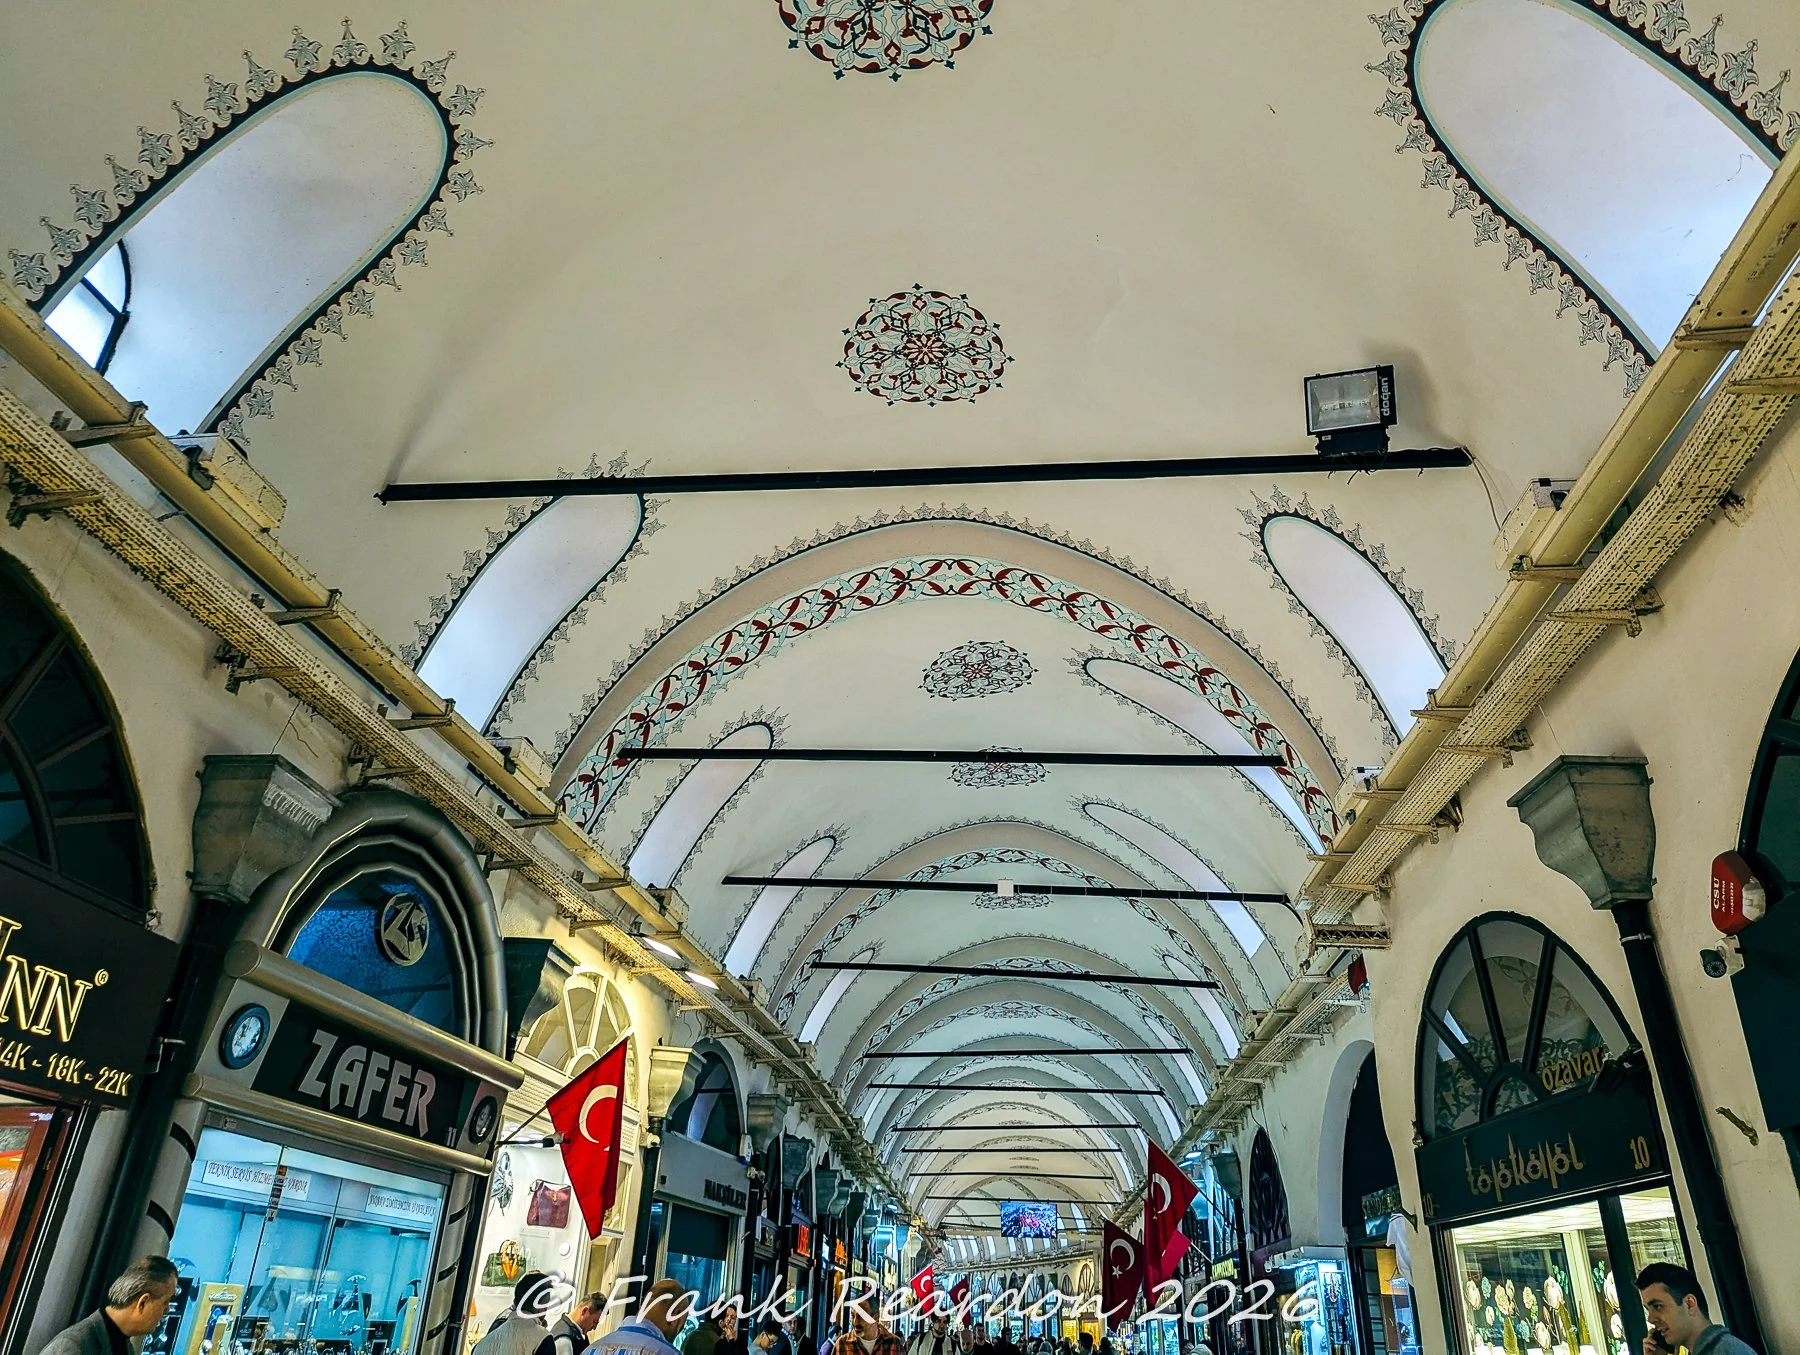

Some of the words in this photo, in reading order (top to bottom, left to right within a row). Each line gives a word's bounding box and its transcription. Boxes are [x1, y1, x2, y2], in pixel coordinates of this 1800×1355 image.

[47, 1053, 86, 1084] 18K
[94, 1066, 133, 1097] 22K
[297, 1029, 436, 1138] ZAFER
[1630, 1137, 1651, 1170] 10
